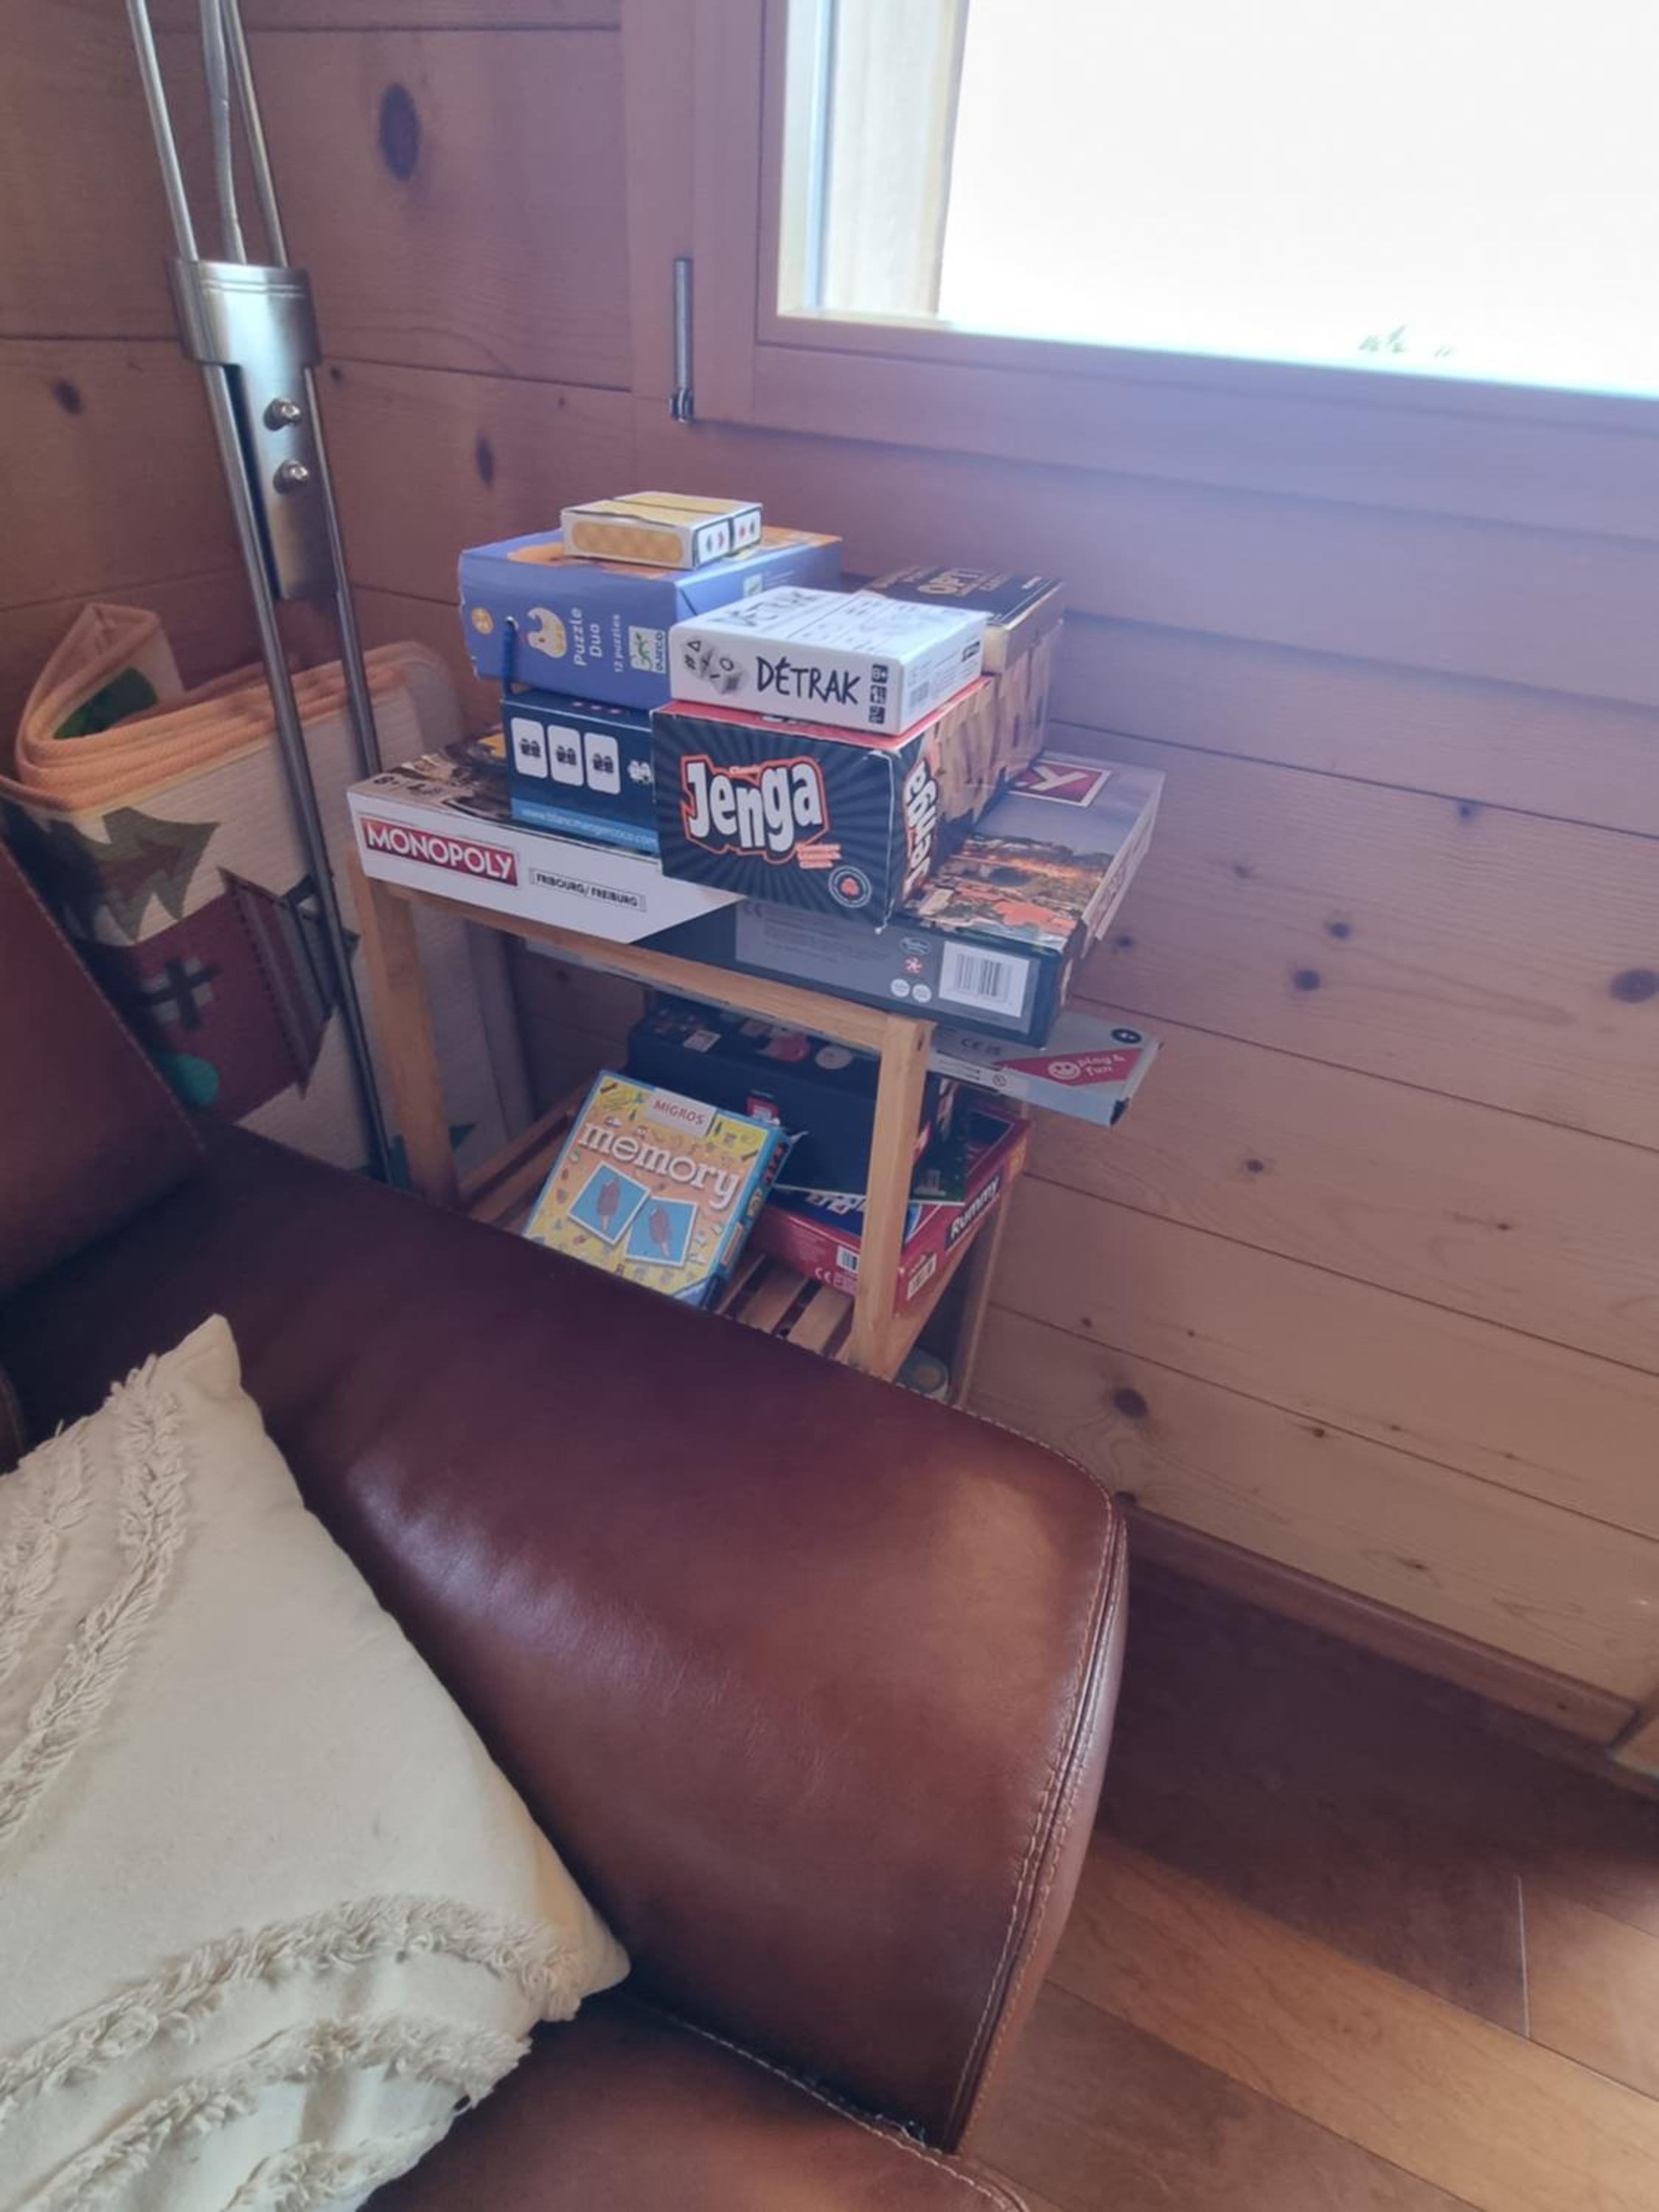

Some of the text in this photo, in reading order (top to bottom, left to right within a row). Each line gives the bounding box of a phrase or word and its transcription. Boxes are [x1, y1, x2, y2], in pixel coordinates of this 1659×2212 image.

[569, 607, 588, 666] Puzzle
[589, 623, 602, 657] Duo
[756, 655, 861, 705] DÉTRAK
[686, 762, 822, 852] Jenga
[902, 759, 938, 901] Jenga
[368, 824, 512, 879] MONOPOLY
[653, 1100, 706, 1124] MIGROS
[577, 1122, 740, 1210] memory
[950, 1176, 1001, 1239] Rummy
